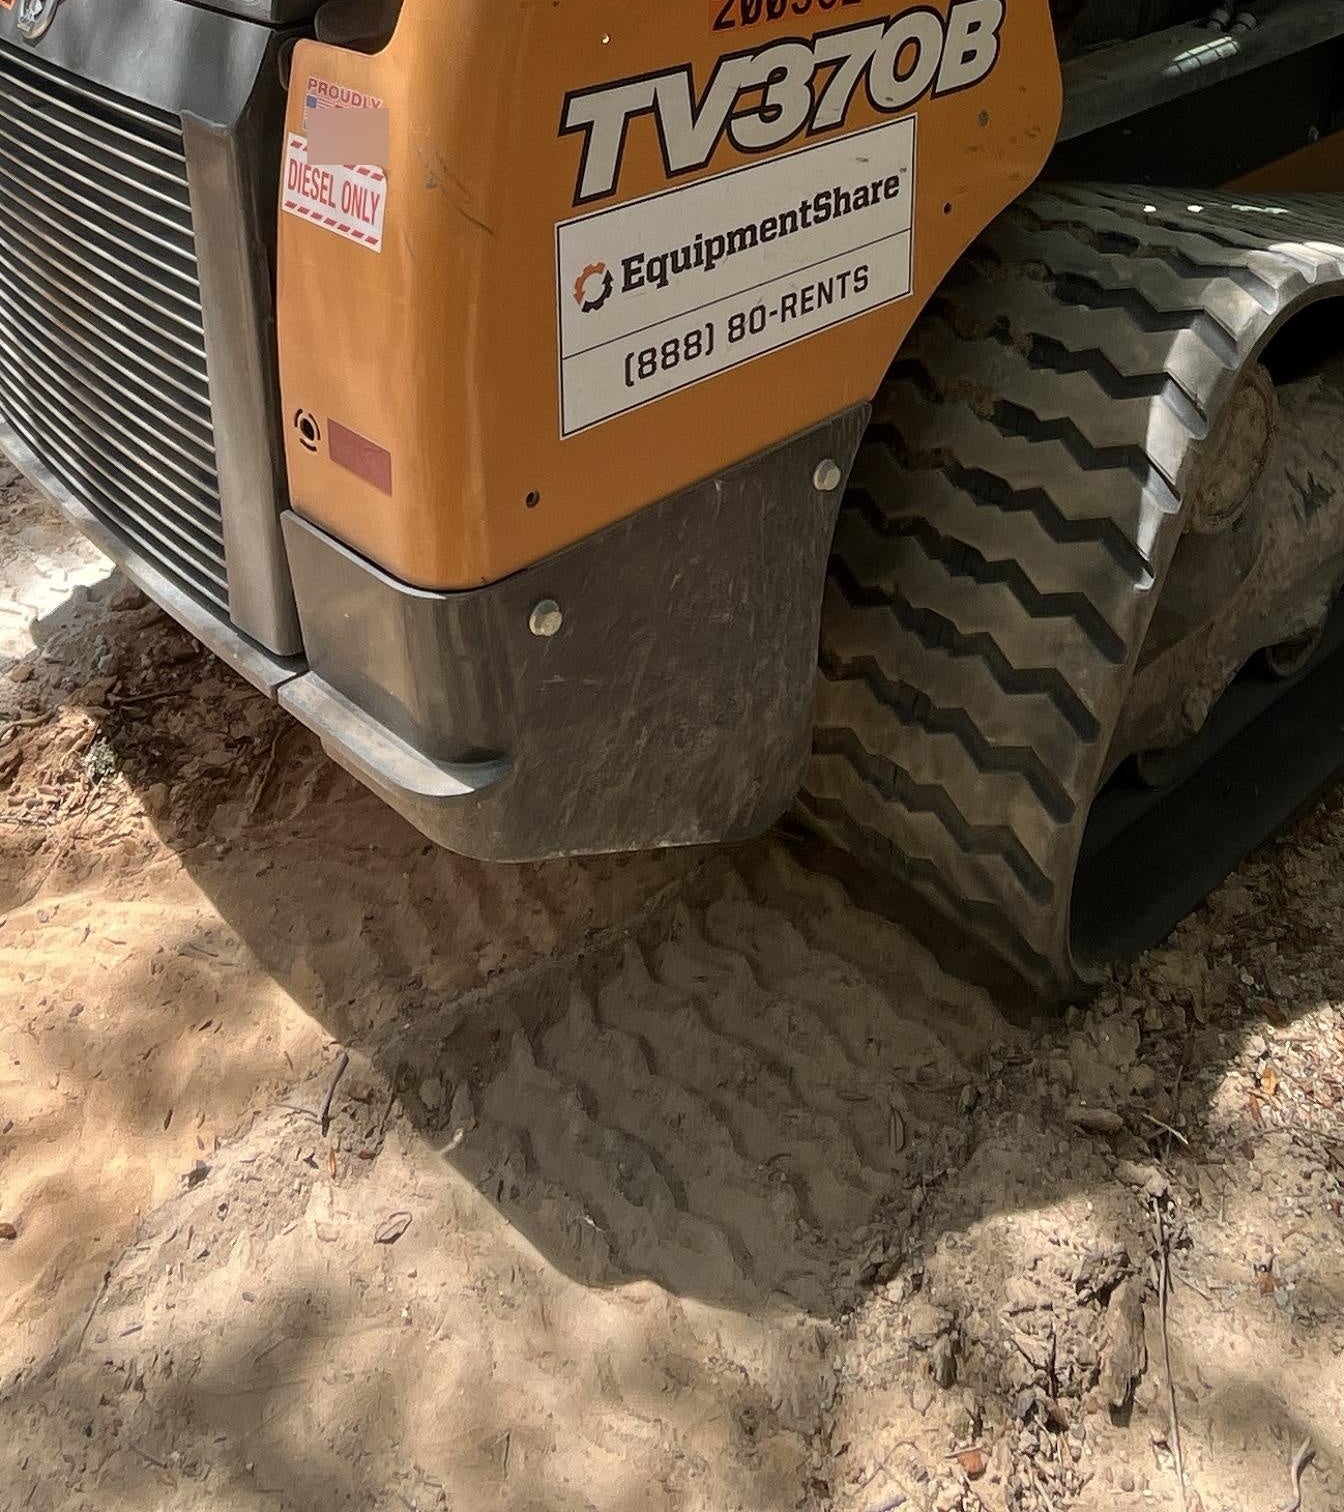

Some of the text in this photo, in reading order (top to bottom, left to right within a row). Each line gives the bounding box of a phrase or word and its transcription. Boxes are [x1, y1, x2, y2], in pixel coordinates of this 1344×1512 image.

[307, 77, 382, 109] PROUDLY
[287, 158, 381, 226] DIESEL ONLY
[620, 174, 901, 293] EquipmentShare
[624, 264, 869, 388] (888) 80-RENTS
